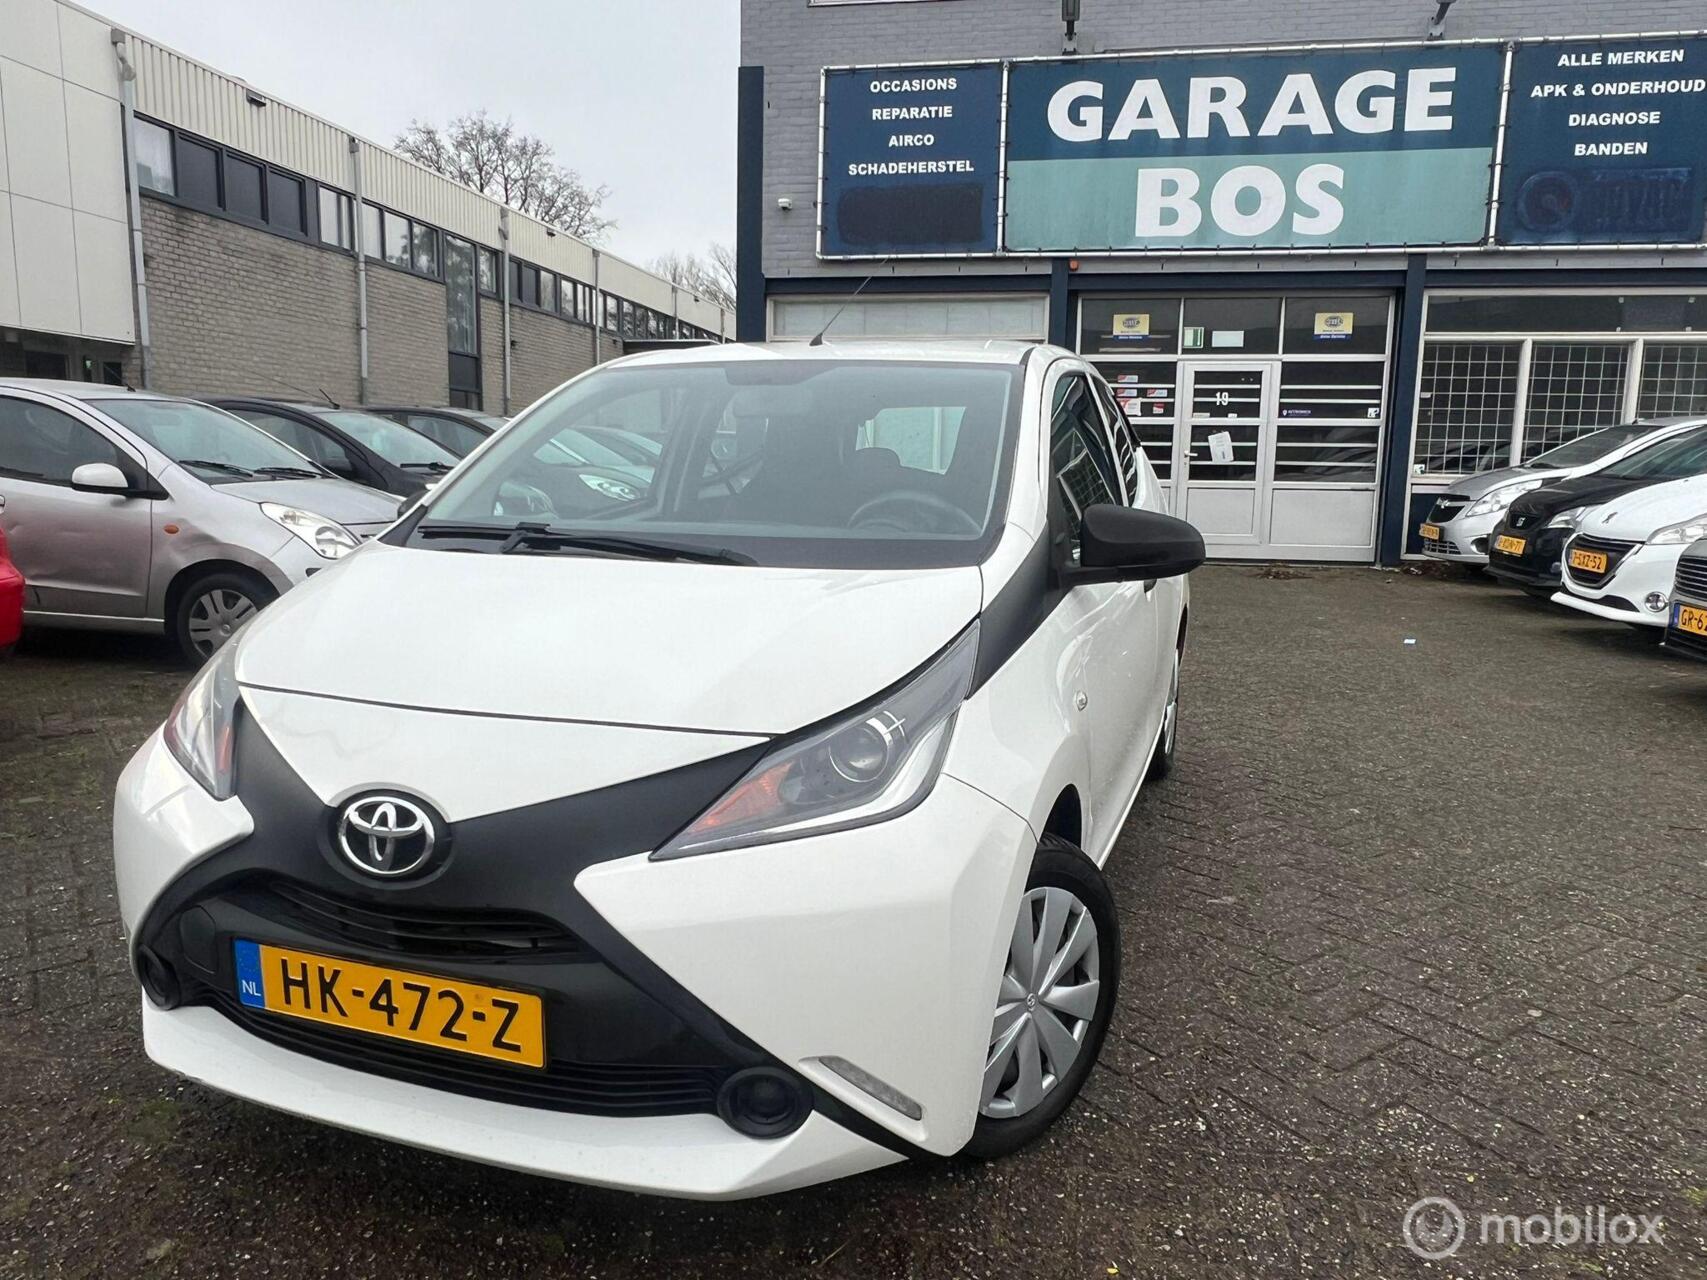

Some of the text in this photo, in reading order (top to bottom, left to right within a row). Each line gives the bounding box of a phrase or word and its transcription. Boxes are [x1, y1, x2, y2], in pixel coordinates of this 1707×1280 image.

[1557, 49, 1685, 67] ALLE MERKEN
[869, 77, 958, 93] OCCASIONS
[1530, 79, 1706, 98] APK & ONDERHOUD
[1047, 66, 1456, 142] GARAGE
[872, 105, 953, 121] REPARATIE
[1568, 111, 1661, 127] DIAGNOSE
[888, 133, 935, 148] AIRCO
[1574, 141, 1648, 156] BANDEN
[848, 159, 975, 176] SCHADEHERSTEL
[1135, 163, 1345, 238] BOS
[1215, 391, 1229, 406] 19
[241, 957, 522, 1053] NL HK-472-Z
